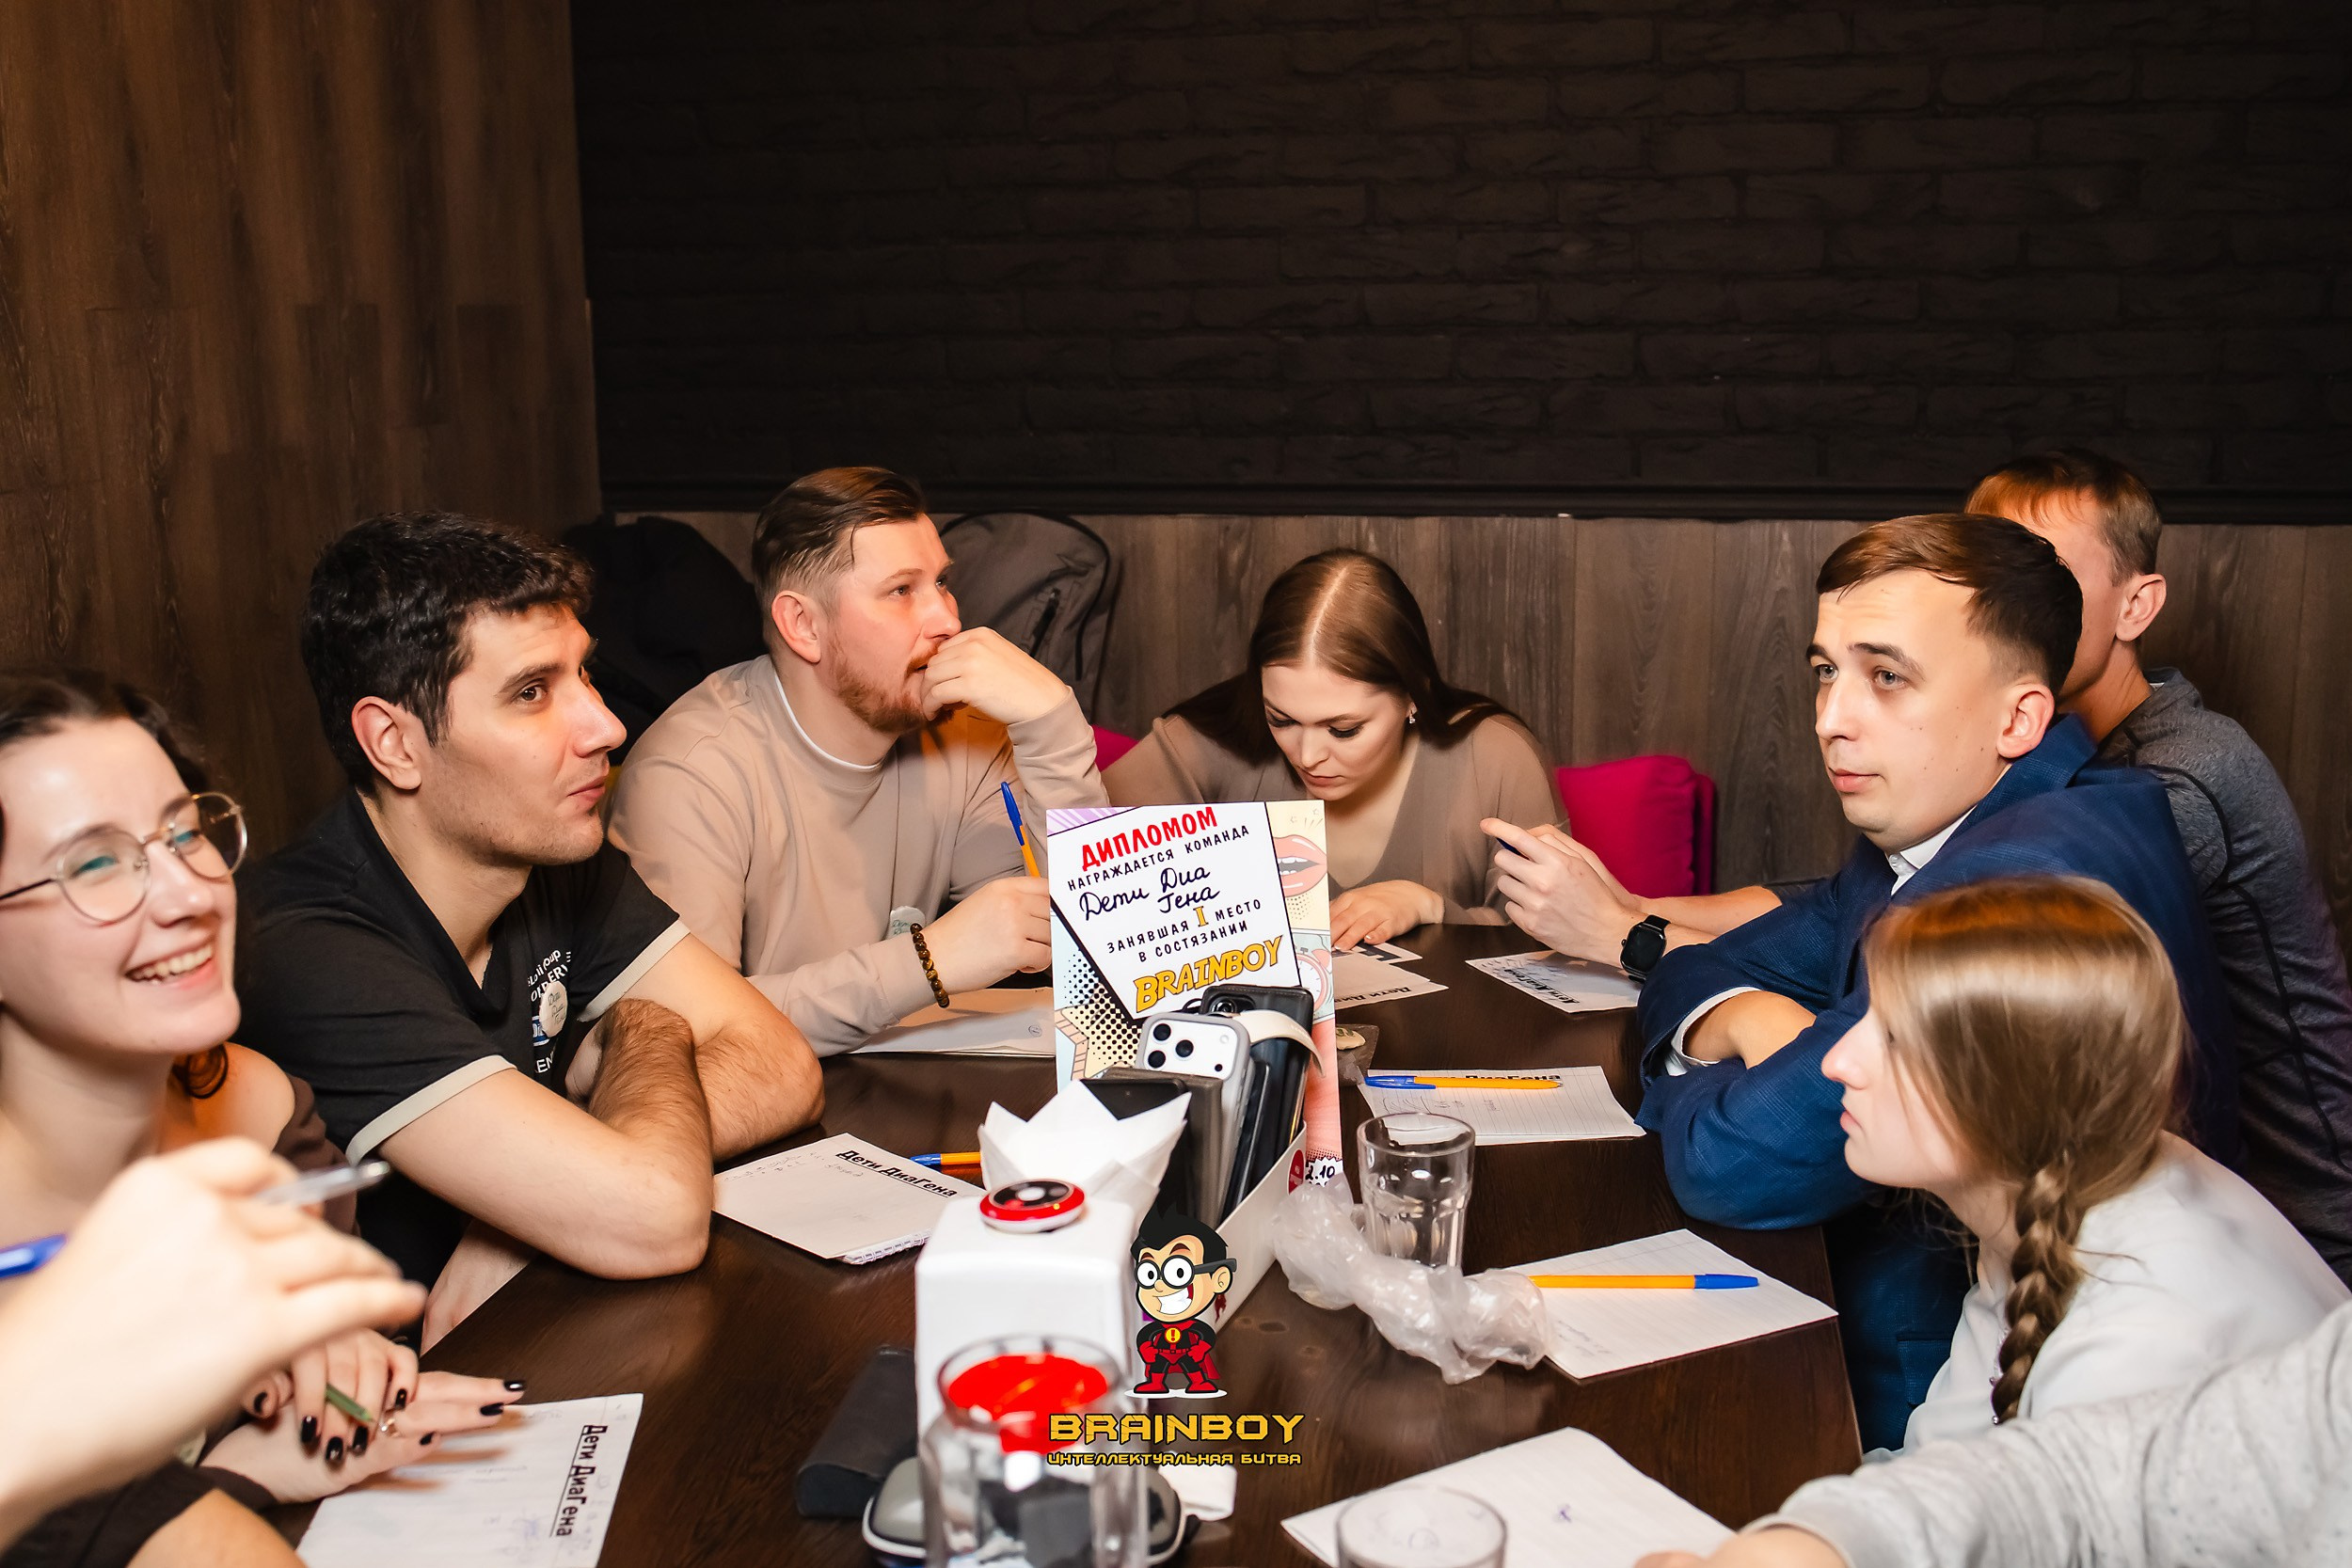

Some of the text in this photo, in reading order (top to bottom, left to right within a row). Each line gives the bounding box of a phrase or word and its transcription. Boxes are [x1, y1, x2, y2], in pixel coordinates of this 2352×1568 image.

[1067, 825, 1250, 892] НАГРАЖДАЕТСЯ КОМАНДА
[1082, 806, 1218, 872] ДИПЛОМОМ
[1079, 866, 1210, 921] Дети Диа
[1157, 886, 1220, 914] Гена
[1106, 920, 1189, 954] ЗАНЯВШАЯ
[1215, 898, 1262, 922] МЕСТО
[1138, 920, 1248, 962] В СОСТЯЗАНИИ
[1133, 934, 1283, 1013] BRAINBOY
[835, 1149, 882, 1169] Дети
[879, 1166, 958, 1197] ДиаГена
[556, 1424, 609, 1537] Дети ДиаГена
